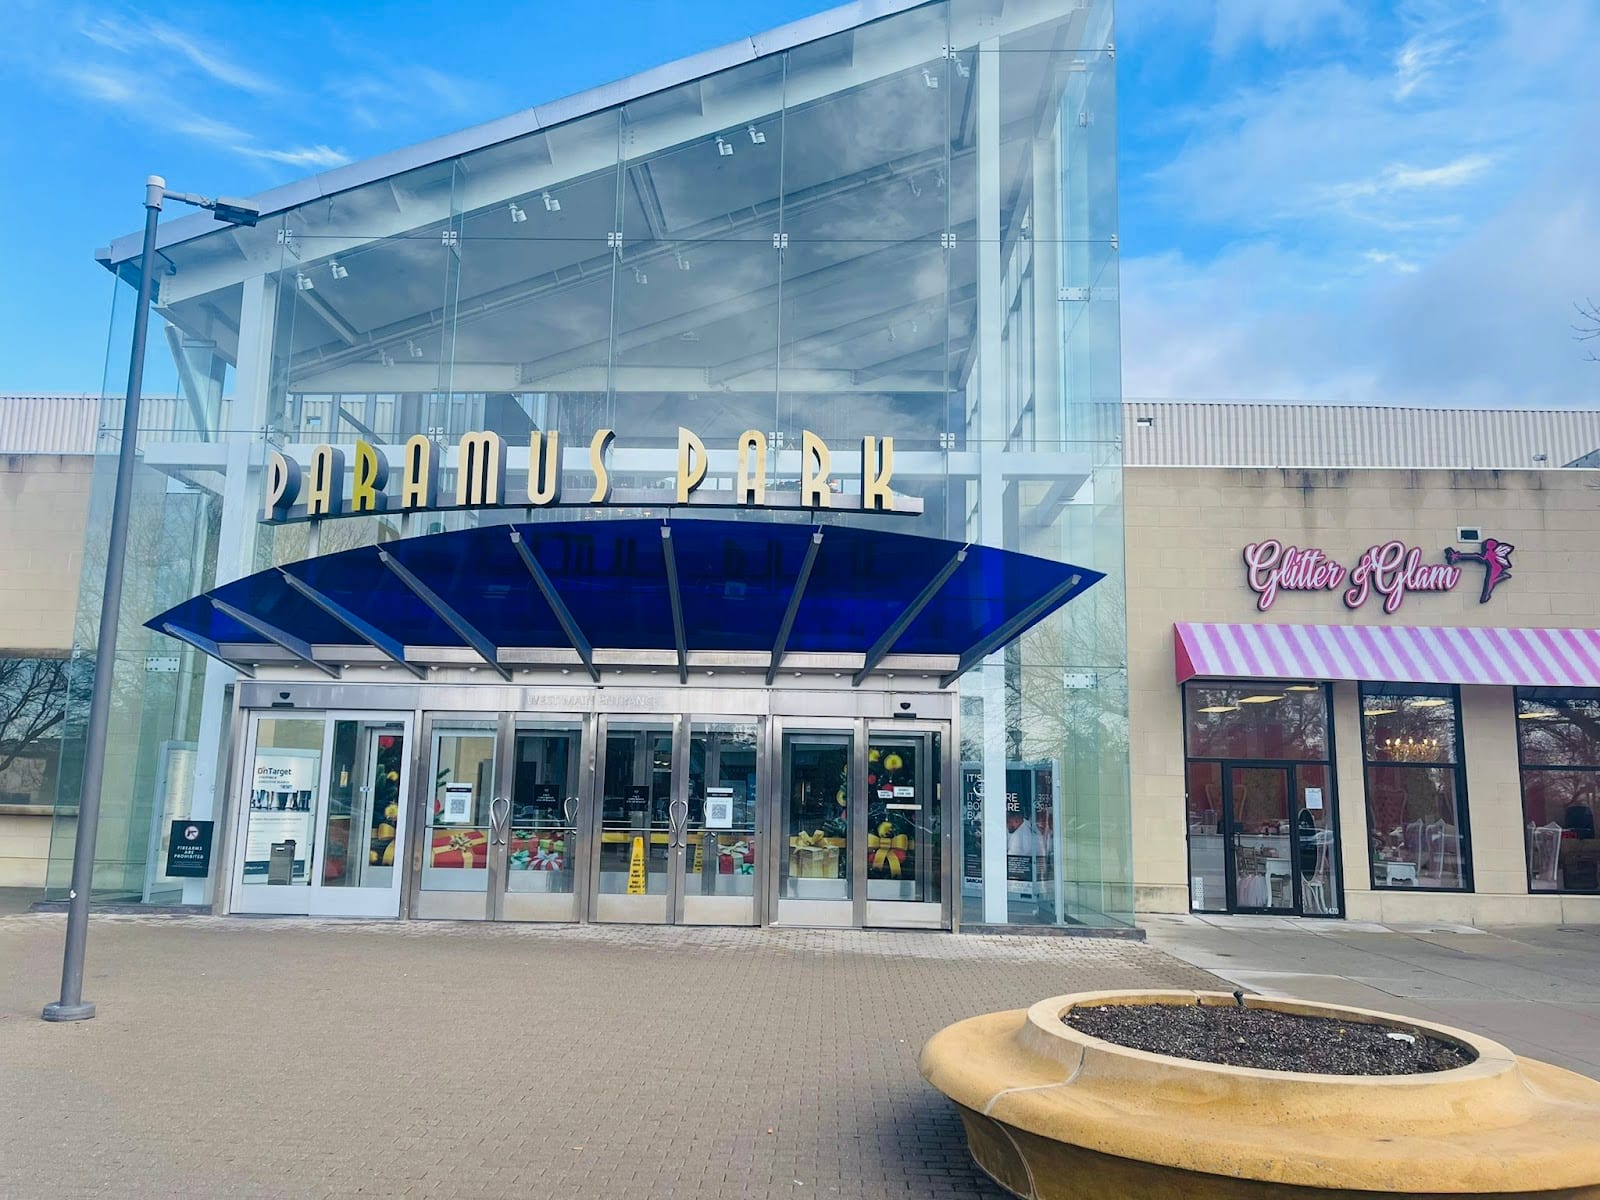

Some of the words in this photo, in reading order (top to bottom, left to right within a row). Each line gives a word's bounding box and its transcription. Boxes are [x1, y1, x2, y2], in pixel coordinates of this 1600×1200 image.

[265, 429, 616, 519] PARAMUS
[678, 426, 895, 509] PARK
[1244, 539, 1347, 611] Glitter
[1369, 541, 1462, 614] Glam
[527, 695, 559, 705] WEST
[257, 767, 292, 777] OnTarget
